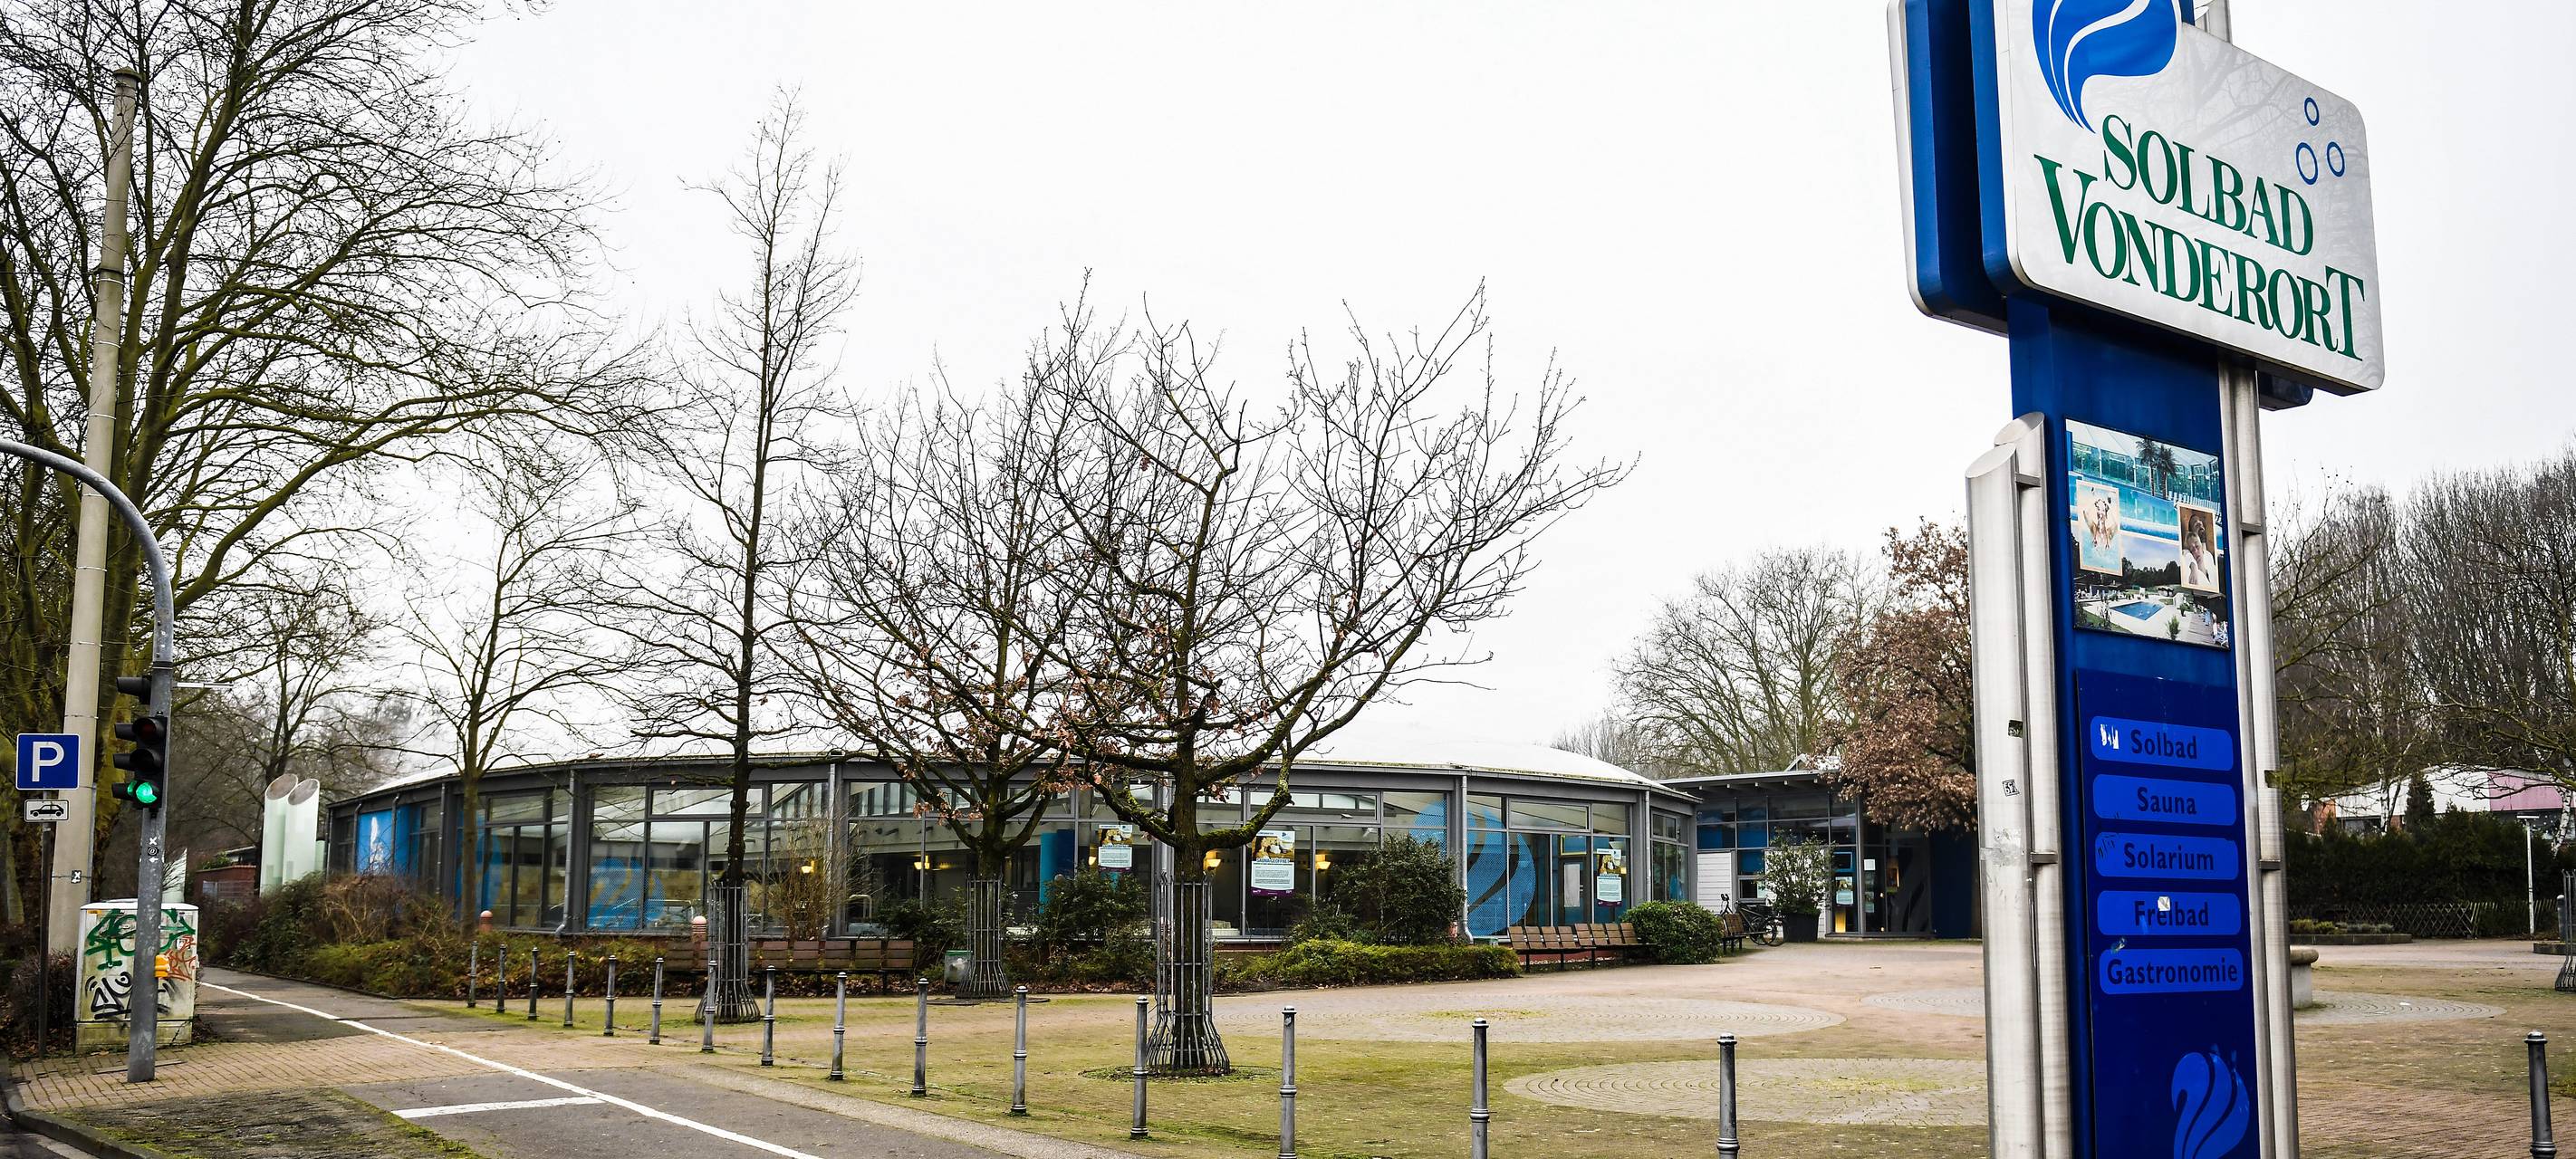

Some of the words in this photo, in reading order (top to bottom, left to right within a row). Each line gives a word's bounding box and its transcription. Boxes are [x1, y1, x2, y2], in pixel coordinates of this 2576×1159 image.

[2102, 114, 2314, 257] SOLBAD
[2033, 154, 2365, 362] VONDERORT
[2130, 729, 2197, 760] Solbad
[32, 741, 64, 782] P
[2137, 786, 2197, 815] Sauna
[2123, 842, 2215, 870] Solarium
[2134, 900, 2209, 926] Freibad
[2107, 956, 2238, 985] Gastronomie
